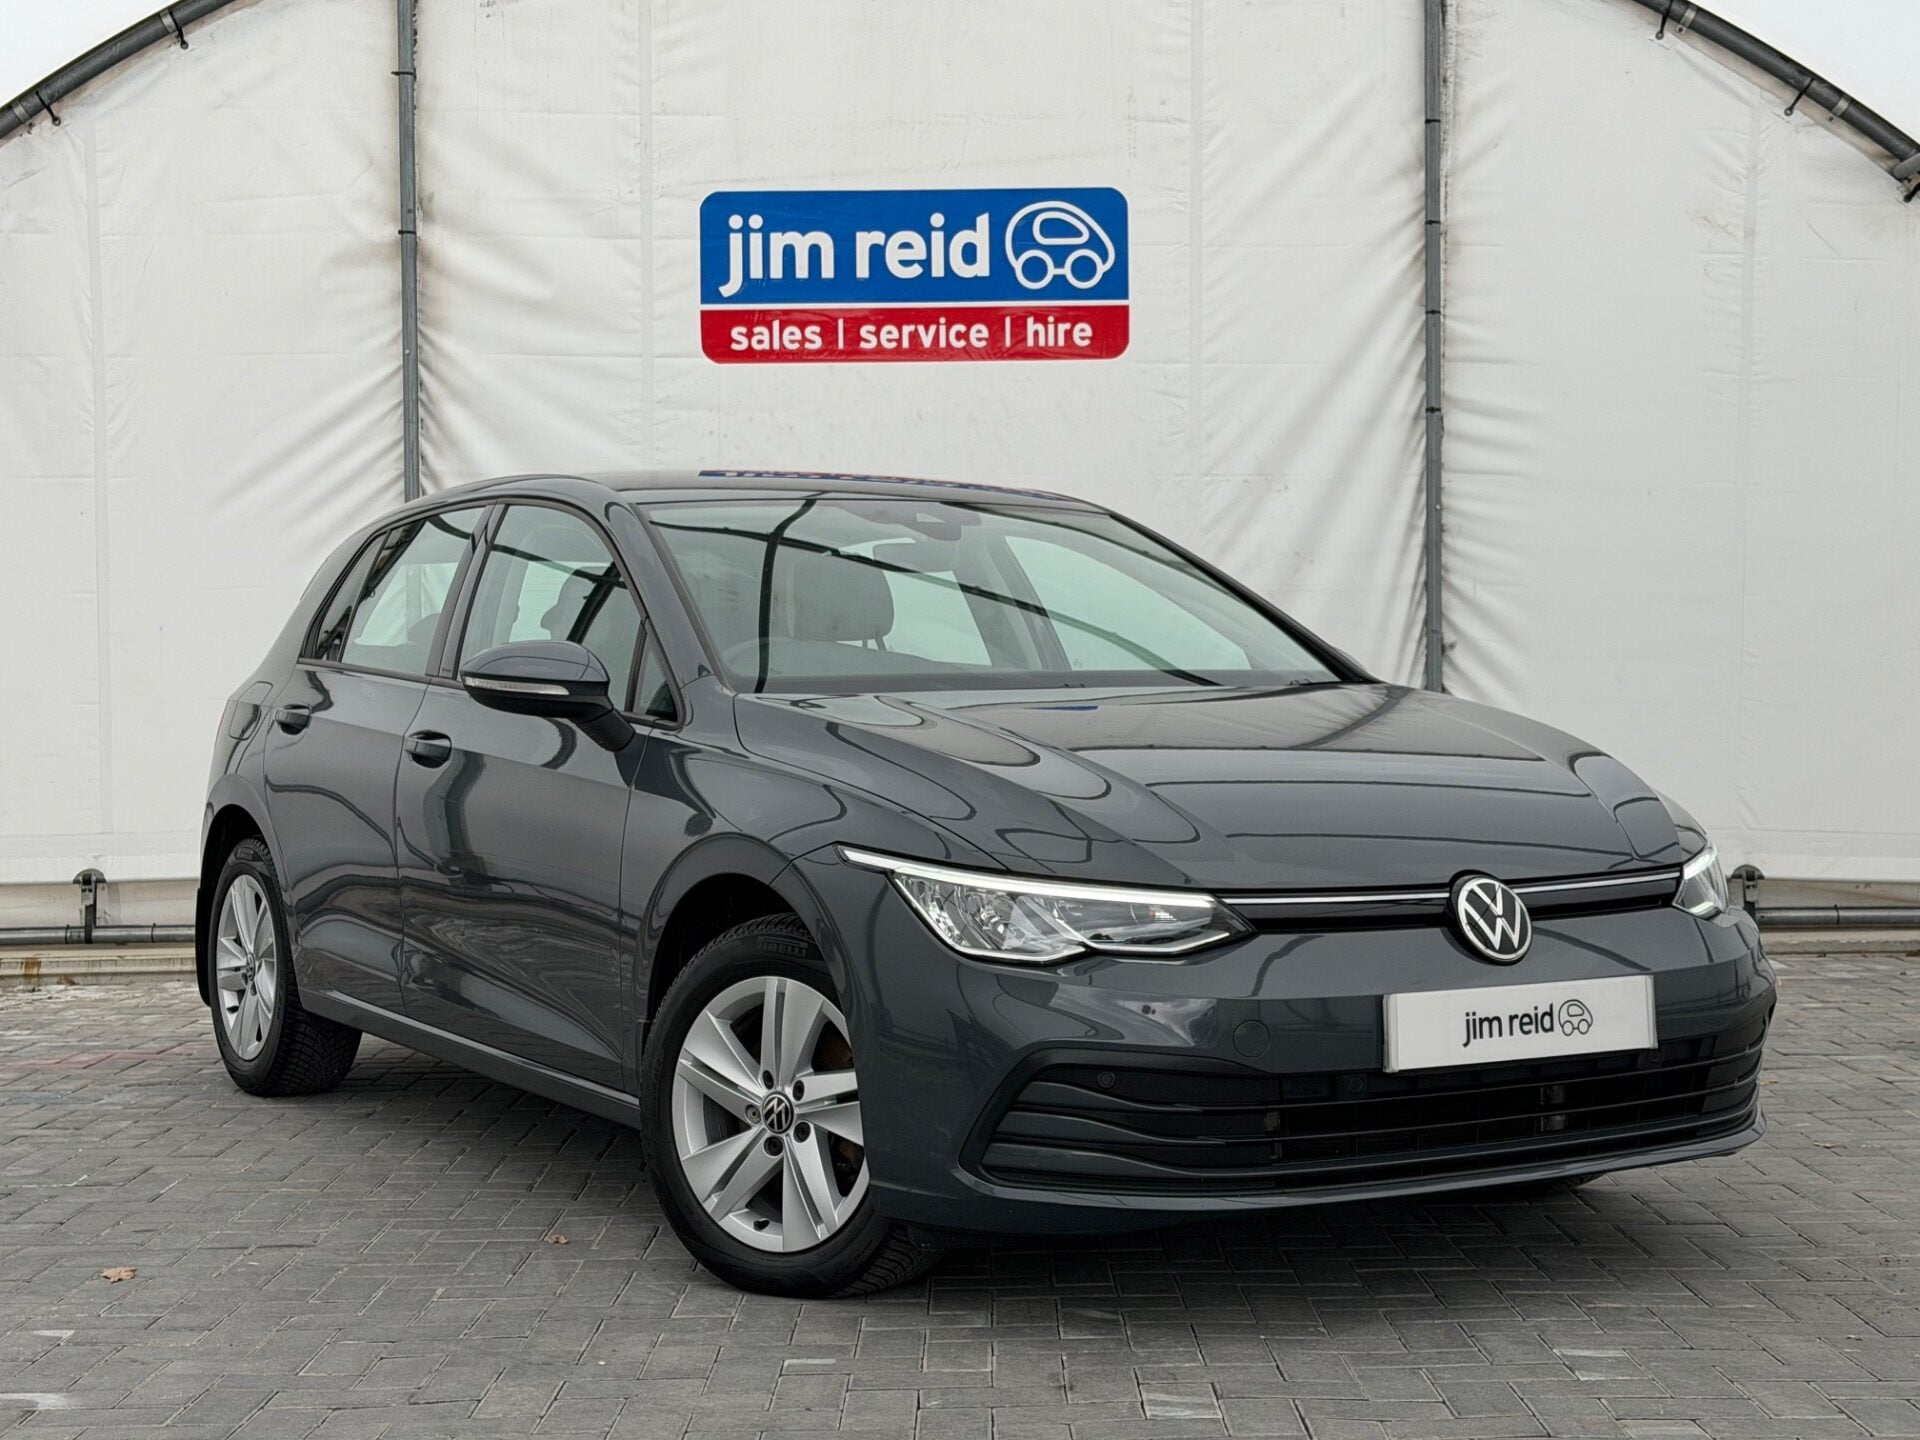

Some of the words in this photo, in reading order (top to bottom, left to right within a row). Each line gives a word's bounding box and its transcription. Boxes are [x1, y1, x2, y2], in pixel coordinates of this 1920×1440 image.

[719, 214, 834, 298] jim
[856, 212, 990, 279] reid
[731, 320, 822, 351] sales
[860, 317, 989, 349] service
[1027, 316, 1092, 347] hire
[1463, 1011, 1502, 1048] jim
[1509, 1003, 1554, 1036] reid
